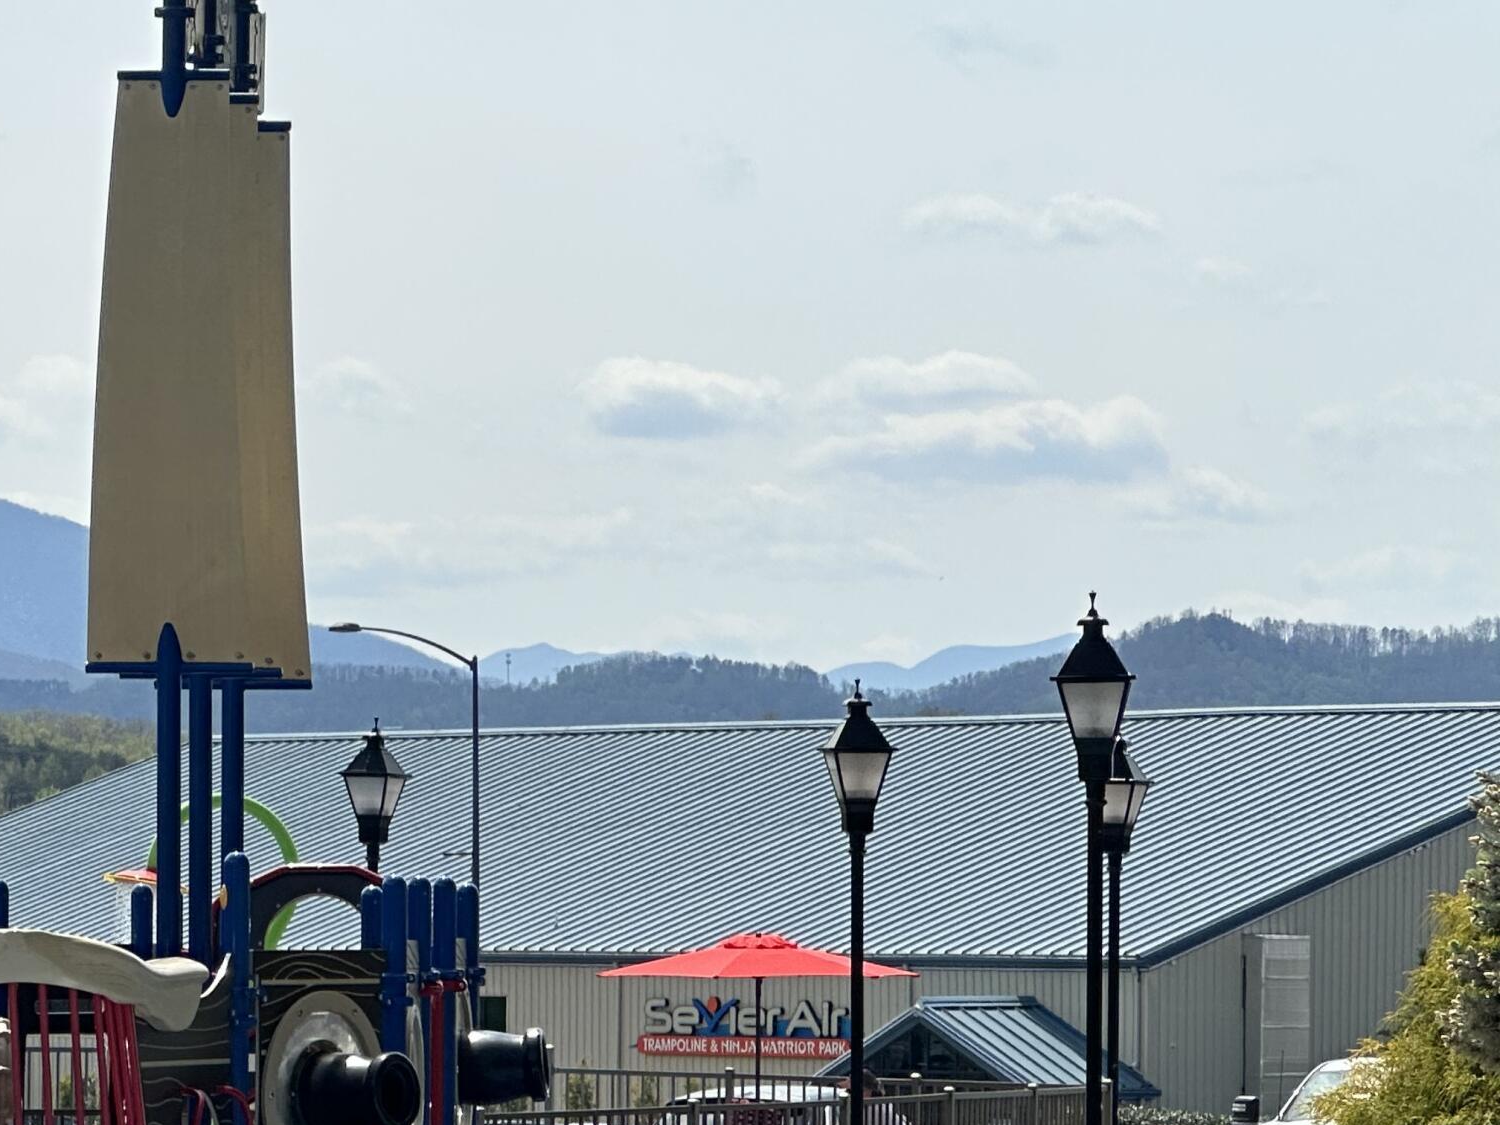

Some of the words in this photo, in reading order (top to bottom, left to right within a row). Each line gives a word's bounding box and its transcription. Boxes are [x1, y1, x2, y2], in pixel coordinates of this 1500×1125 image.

[643, 1038, 707, 1053] TRAMPOLINE
[710, 1040, 718, 1053] &
[721, 1039, 757, 1053] NINJA
[760, 1040, 815, 1055] WARRIOR
[819, 1041, 847, 1055] PARK
